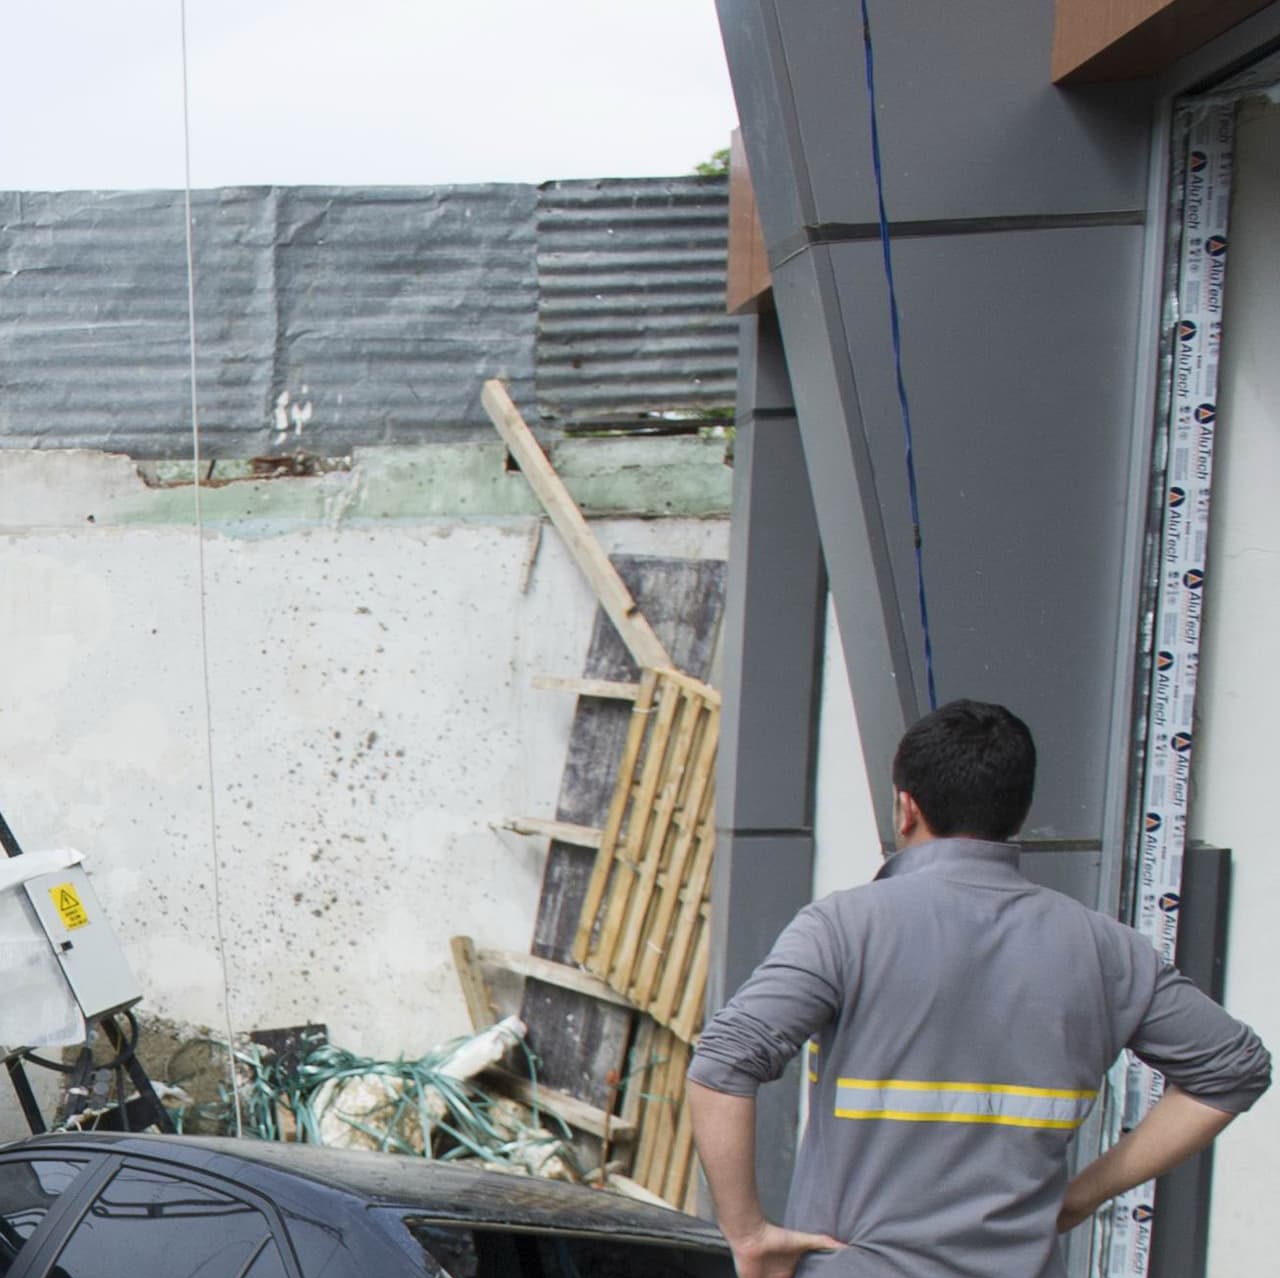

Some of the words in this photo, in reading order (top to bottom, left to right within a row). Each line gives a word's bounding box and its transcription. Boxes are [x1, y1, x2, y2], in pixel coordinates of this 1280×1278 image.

[1187, 175, 1203, 229] AluTech
[1208, 259, 1223, 312] AluTech
[1176, 345, 1192, 398] AluTech
[1197, 426, 1213, 480] AluTech
[1166, 510, 1182, 563] AluTech
[1186, 592, 1202, 644] AluTech
[1154, 673, 1169, 726] AluTech
[1174, 755, 1189, 808] AluTech
[1142, 835, 1158, 887] AluTech
[1134, 1226, 1149, 1274] AluTech
